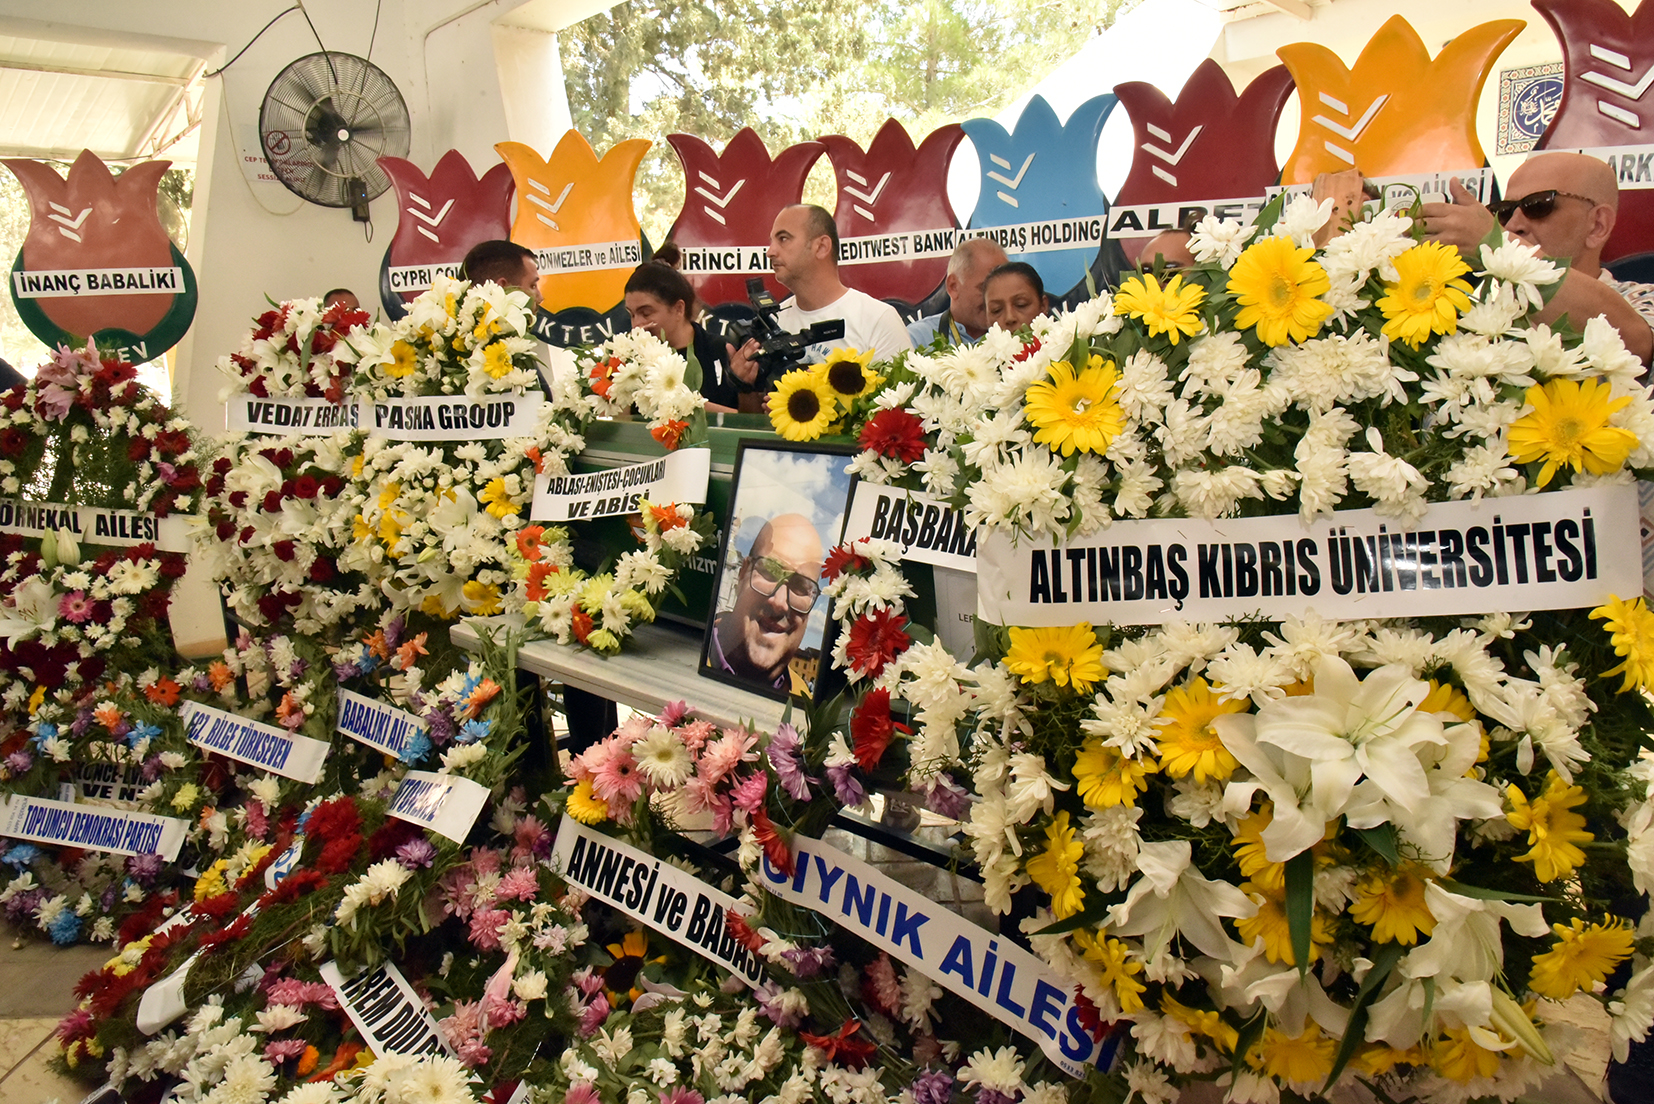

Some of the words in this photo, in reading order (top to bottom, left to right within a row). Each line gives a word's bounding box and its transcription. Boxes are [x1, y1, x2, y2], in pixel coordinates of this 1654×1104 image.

[838, 235, 908, 261] EDITWEST
[913, 231, 954, 253] BANK
[1031, 220, 1100, 246] HOLDING
[594, 251, 606, 265] ve
[609, 242, 641, 264] AİLESİ
[682, 248, 742, 270] İRİNCİ
[20, 272, 81, 295] İNANÇ
[86, 269, 176, 291] BABALİKİ
[391, 268, 432, 288] CYPRI
[537, 316, 615, 345] KTEV
[247, 401, 313, 428] VEDAT
[375, 404, 435, 430] PASHA
[438, 401, 515, 430] GROUP
[568, 501, 592, 519] VE
[1030, 543, 1190, 611] ALTINBAŞ
[1197, 537, 1322, 598] KIBRIS
[1327, 506, 1598, 596] ÜNİVERSİTESİ
[340, 698, 392, 746] BABALİKİ
[204, 714, 240, 751] BİLGE
[232, 722, 293, 770] TÜRKSEVEN
[83, 783, 113, 799] VE
[21, 804, 74, 841] TOPLUMCU
[68, 812, 129, 849] DEMOKRASİ
[121, 818, 165, 854] PARTİSİ
[567, 834, 660, 915] ANNESİ
[653, 883, 688, 932] ve
